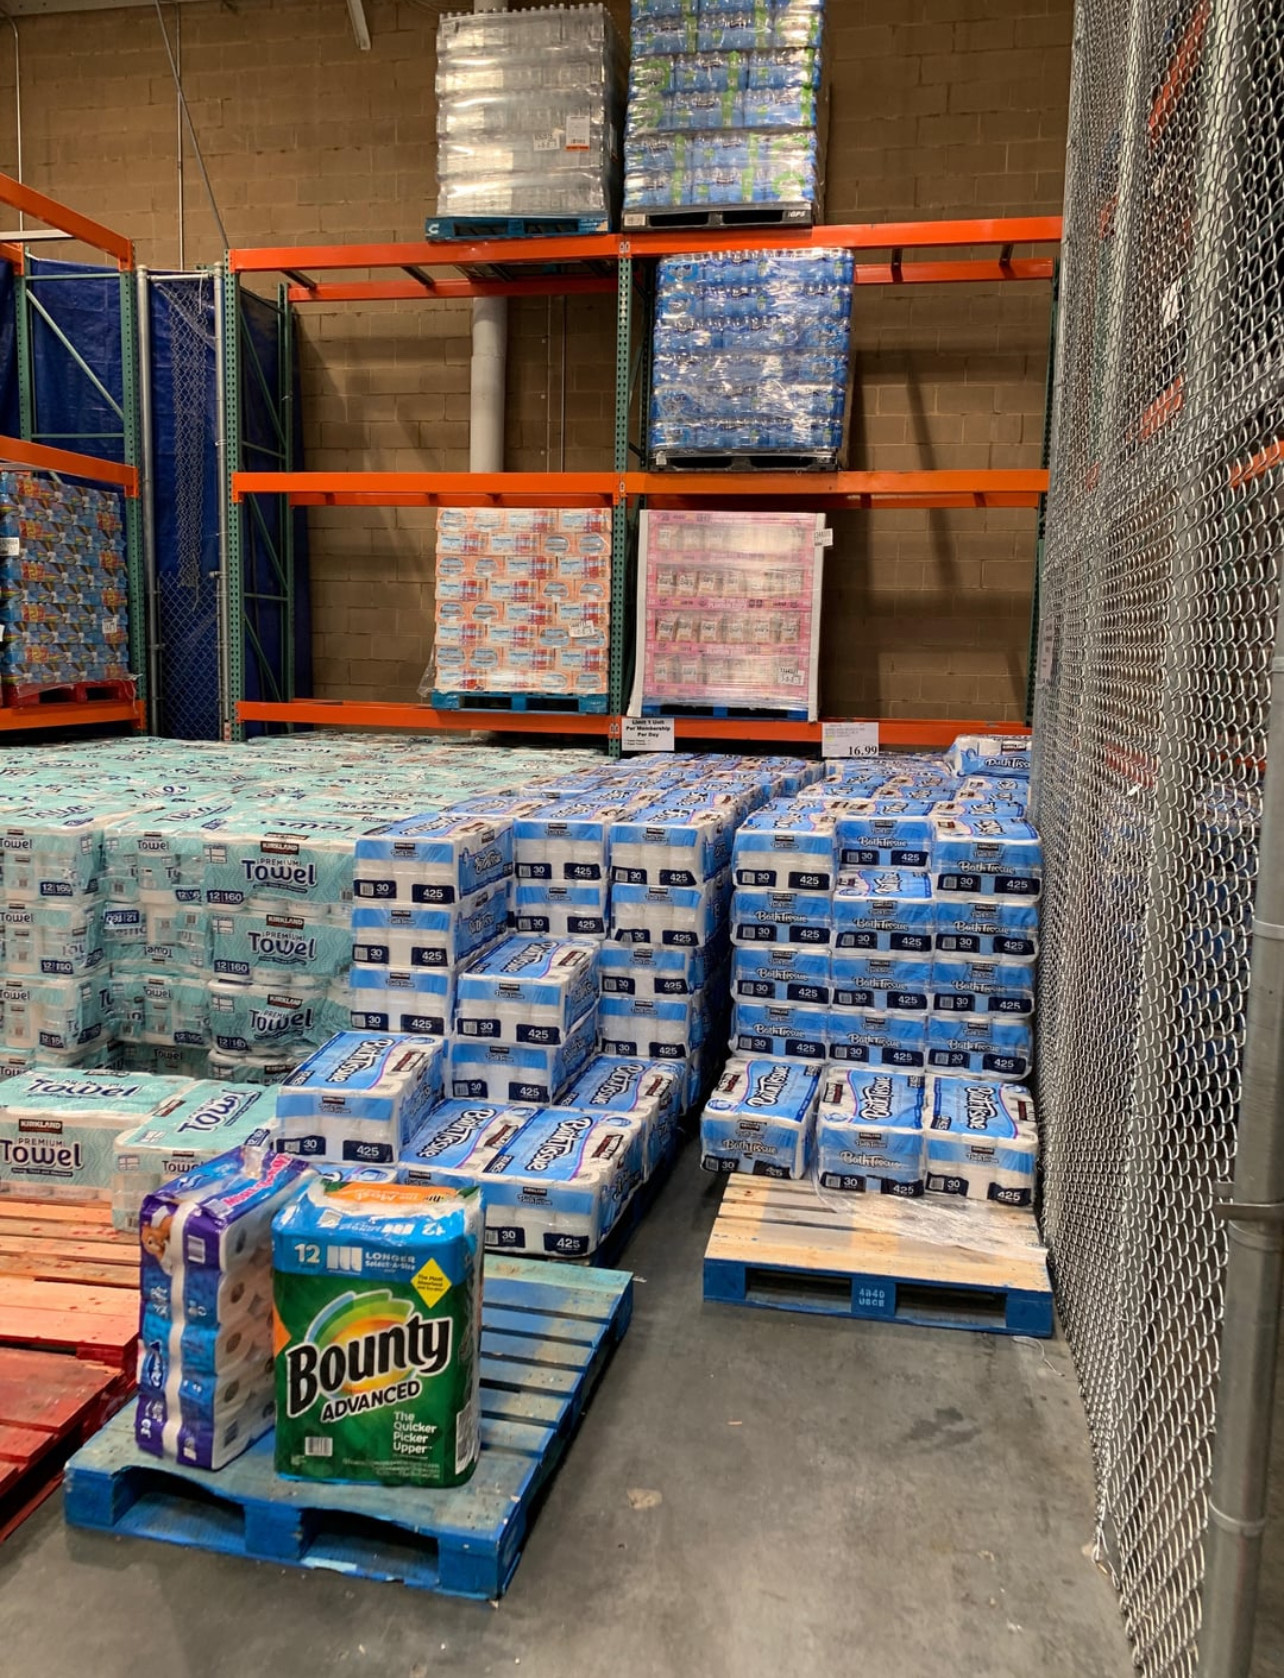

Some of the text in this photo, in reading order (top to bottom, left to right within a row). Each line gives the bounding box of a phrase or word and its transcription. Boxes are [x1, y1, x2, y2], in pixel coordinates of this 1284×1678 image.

[849, 746, 878, 756] 16.99
[138, 840, 170, 850] Towel
[901, 854, 920, 862] 425
[241, 860, 316, 886] Towel
[533, 865, 545, 874] 30
[574, 866, 592, 876] 425
[631, 872, 642, 880] 30
[670, 873, 688, 882] 425
[800, 876, 819, 884] 425
[376, 883, 389, 893] 30
[1006, 880, 1028, 888] 425
[225, 892, 242, 901] 160
[423, 888, 443, 899] 425
[534, 919, 544, 928] 30
[577, 920, 596, 929] 425
[673, 934, 692, 944] 425
[902, 938, 922, 946] 425
[247, 932, 316, 958] Towel
[1004, 942, 1024, 950] 425
[371, 949, 382, 958] 30
[422, 951, 442, 961] 425
[232, 962, 247, 972] 160
[664, 982, 682, 990] 425
[799, 990, 818, 998] 425
[249, 1008, 312, 1031] Towel
[368, 1015, 381, 1025] 30
[412, 1019, 432, 1030] 425
[480, 1021, 493, 1030] 30
[528, 1028, 548, 1039] 425
[659, 1046, 678, 1056] 425
[796, 1044, 816, 1053] 425
[994, 1059, 1014, 1068] 425
[28, 1078, 139, 1096] Towel
[471, 1082, 482, 1091] 30
[520, 1087, 540, 1096] 425
[19, 1138, 63, 1147] PREMIUM
[304, 1140, 317, 1148] 30
[0, 1140, 81, 1167] Towel
[357, 1146, 379, 1156] 425
[722, 1161, 734, 1169] 30
[844, 1178, 858, 1186] 30
[894, 1186, 914, 1194] 425
[502, 1231, 516, 1240] 30
[557, 1238, 580, 1248] 425
[294, 1244, 321, 1264] 12
[366, 1252, 416, 1263] LONGER
[286, 1315, 451, 1416] Bounty
[322, 1381, 421, 1422] ADVANCED
[394, 1411, 415, 1422] The
[394, 1422, 438, 1434] Quicker
[394, 1432, 428, 1443] Picker
